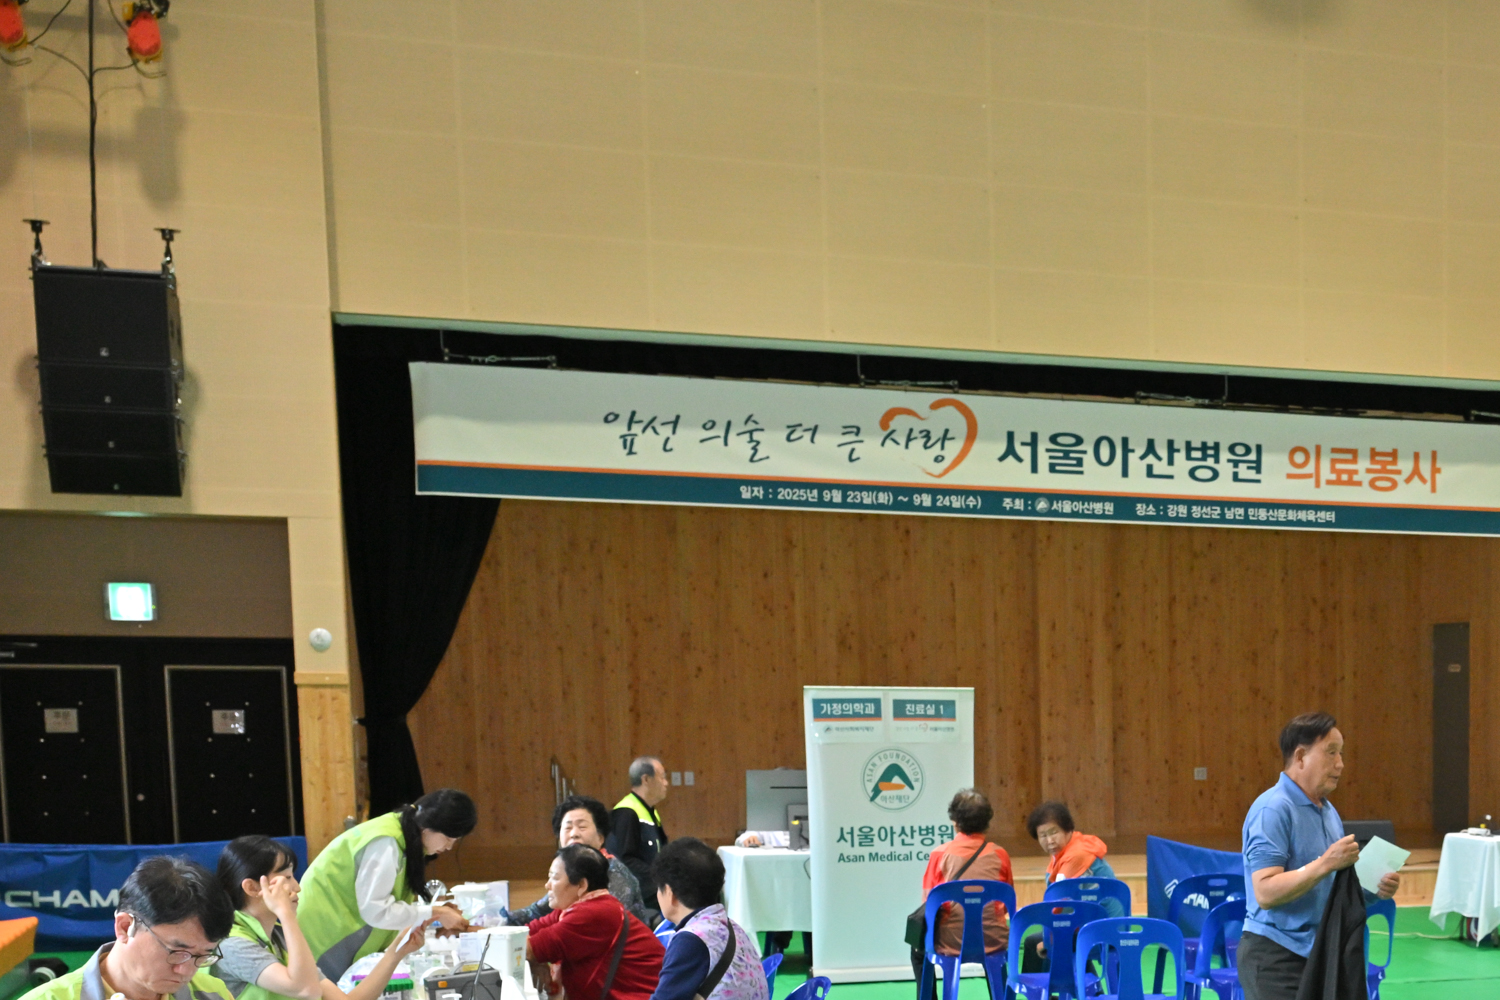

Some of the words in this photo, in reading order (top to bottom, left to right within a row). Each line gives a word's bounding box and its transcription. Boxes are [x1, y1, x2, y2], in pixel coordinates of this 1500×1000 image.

[603, 410, 681, 454] 앞선
[700, 414, 770, 463] 의술
[785, 423, 817, 445] 더
[837, 427, 864, 463] 큰
[880, 429, 956, 464] 사랑
[997, 430, 1262, 483] 서울아산병원
[1286, 443, 1442, 494] 의료봉사
[740, 486, 764, 500] 일자
[777, 488, 818, 502] 2025년
[823, 490, 842, 503] 9월
[847, 491, 893, 506] 23일(화)
[913, 494, 932, 507] 9월
[936, 495, 982, 509] 24일(수)
[1002, 498, 1024, 511] 주최
[1051, 500, 1114, 515] 서울아산병원
[1136, 503, 1156, 516] 장소
[1167, 504, 1188, 518] 강원
[1191, 505, 1221, 519] 정선군
[1225, 506, 1245, 520] 남면
[820, 702, 875, 715] 가정의학과
[905, 703, 935, 715] 진료실
[866, 762, 878, 783] ASAN
[878, 752, 920, 783] FOUNDATION
[836, 825, 954, 848] 서울아산병원
[838, 853, 866, 863] Asan
[868, 852, 913, 863] Medical
[4, 889, 119, 908] CHAM
